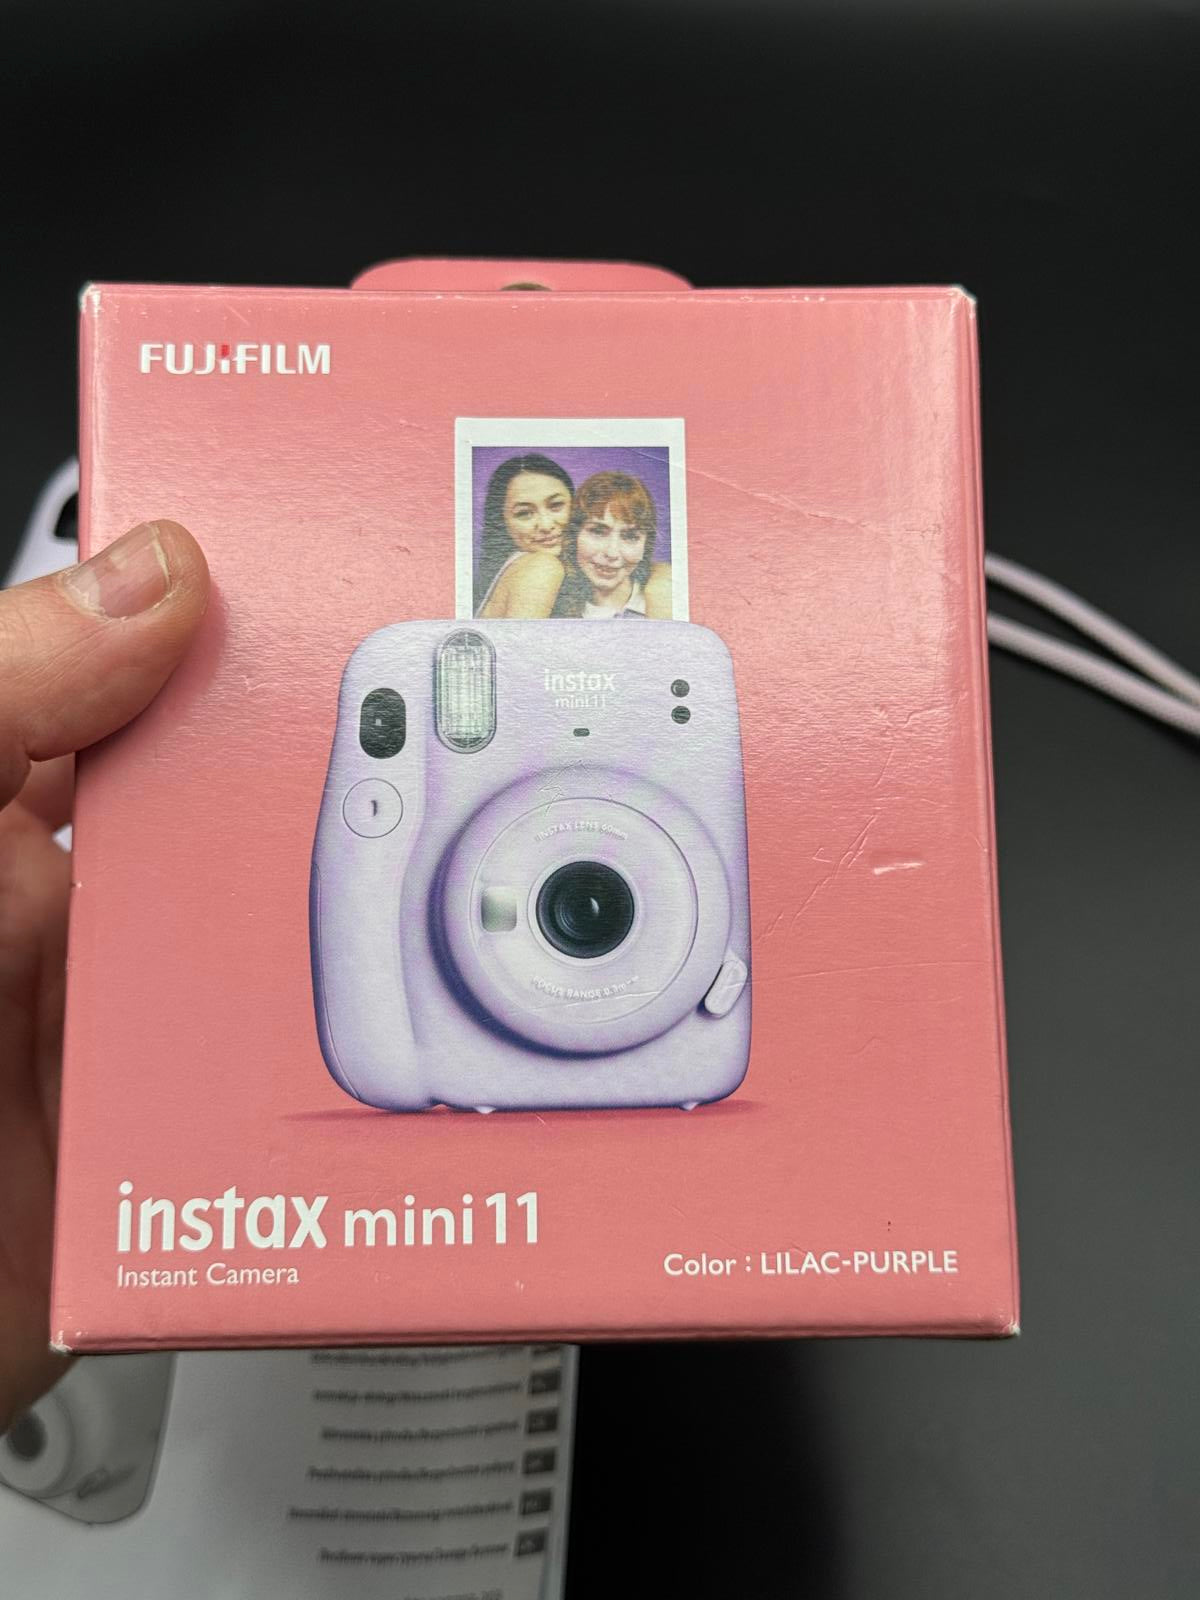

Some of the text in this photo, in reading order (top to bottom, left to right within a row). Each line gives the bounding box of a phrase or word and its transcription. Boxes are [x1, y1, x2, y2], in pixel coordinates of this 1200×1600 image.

[140, 343, 331, 375] FUJIFILM
[543, 669, 616, 692] instax
[117, 1181, 328, 1252] instax
[117, 1262, 299, 1288] Instant Camera
[663, 1252, 737, 1276] Color
[760, 1250, 959, 1274] LILAC-PURPLE
